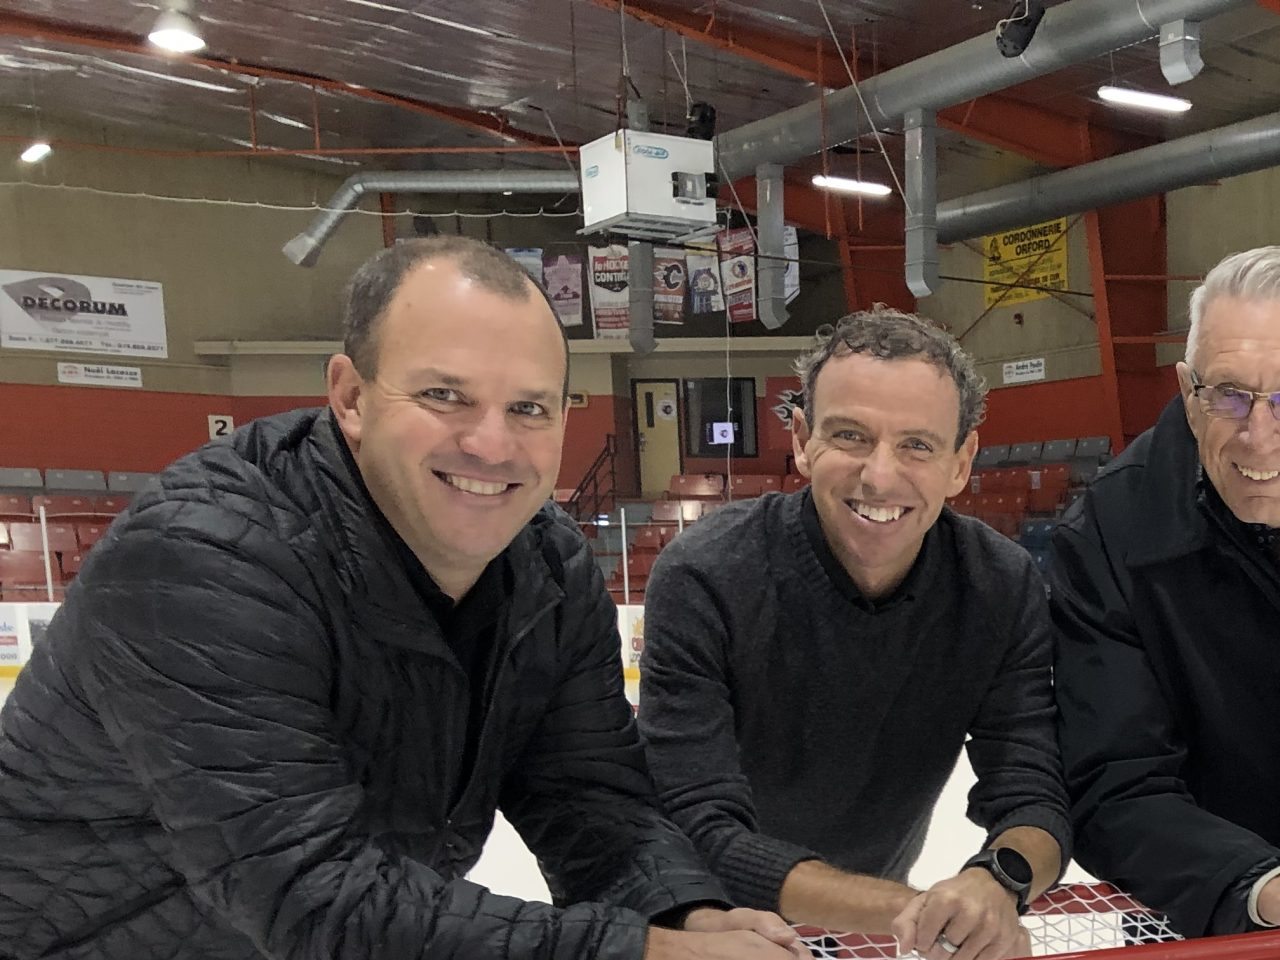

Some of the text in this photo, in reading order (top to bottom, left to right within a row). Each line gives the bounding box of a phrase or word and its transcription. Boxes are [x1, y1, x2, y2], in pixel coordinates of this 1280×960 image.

[1002, 222, 1062, 246] CORDONNERIE
[1015, 239, 1051, 256] ORFORD
[22, 295, 129, 317] DECORUM
[215, 420, 228, 437] 2
